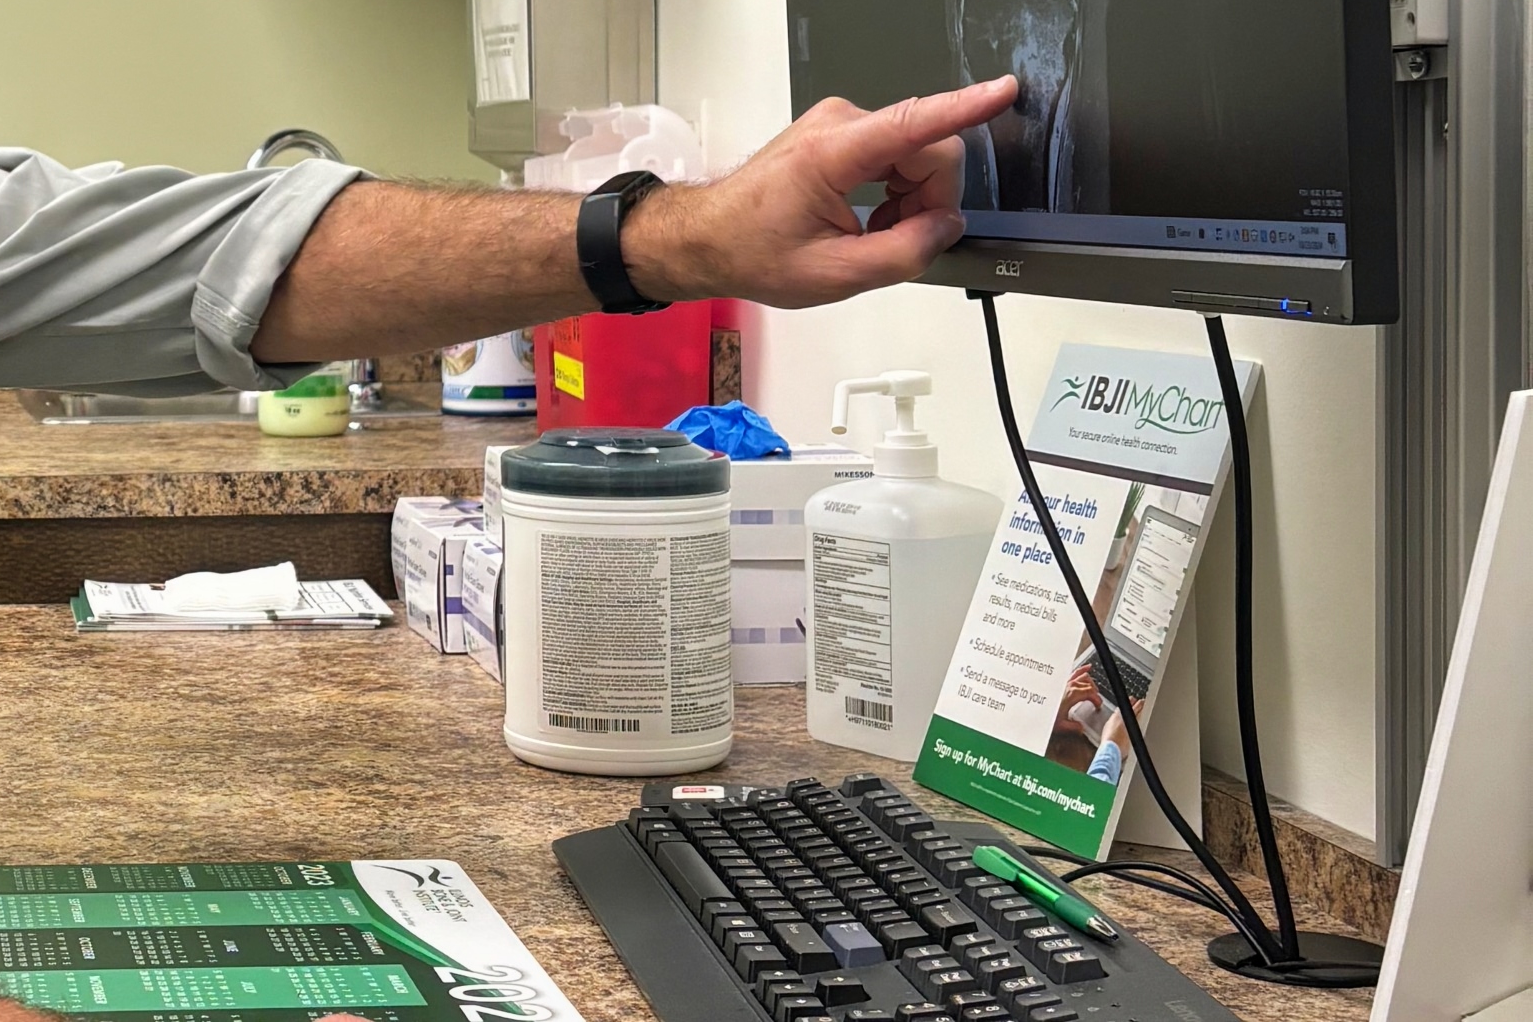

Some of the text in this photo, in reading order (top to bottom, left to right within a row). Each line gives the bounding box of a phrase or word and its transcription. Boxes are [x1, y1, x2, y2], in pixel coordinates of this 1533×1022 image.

[996, 259, 1024, 277] acer
[1081, 375, 1226, 435] IBJI MyChart
[1068, 426, 1178, 455] Your secure online health connection.
[1061, 494, 1097, 519] health
[1009, 511, 1086, 545] informion in
[1001, 539, 1053, 565] one place
[995, 572, 1069, 605] See medications, test
[988, 594, 1058, 623] results, medical bills
[982, 612, 1016, 631] and more
[973, 637, 1055, 676] Schedule appointments
[958, 683, 1006, 712] IBJI care team
[964, 665, 983, 682] Send
[988, 677, 1019, 698] message
[1019, 687, 1029, 699] to
[1027, 692, 1047, 705] your
[933, 738, 952, 759] Sign
[952, 748, 964, 764] up
[965, 750, 977, 768] for
[977, 756, 1013, 783] MyChart
[1011, 772, 1023, 787] at
[1022, 776, 1096, 818] ibji.com/mychart.
[81, 868, 97, 889] DECEMBER
[177, 866, 196, 888] NOVEMBER
[273, 866, 293, 885] OCTOBER
[297, 864, 335, 886] 2023
[69, 898, 85, 923] SEPTEMBER
[207, 904, 221, 914] MAY
[338, 896, 361, 916] JANUARY
[78, 937, 96, 960] OCTOBER
[223, 940, 239, 953] JUNE
[361, 931, 385, 956] FEBRUARY
[89, 976, 107, 1004] NOVEMBER
[241, 981, 257, 994] JULY
[387, 974, 409, 994] MARCH
[433, 964, 554, 1022] 202
